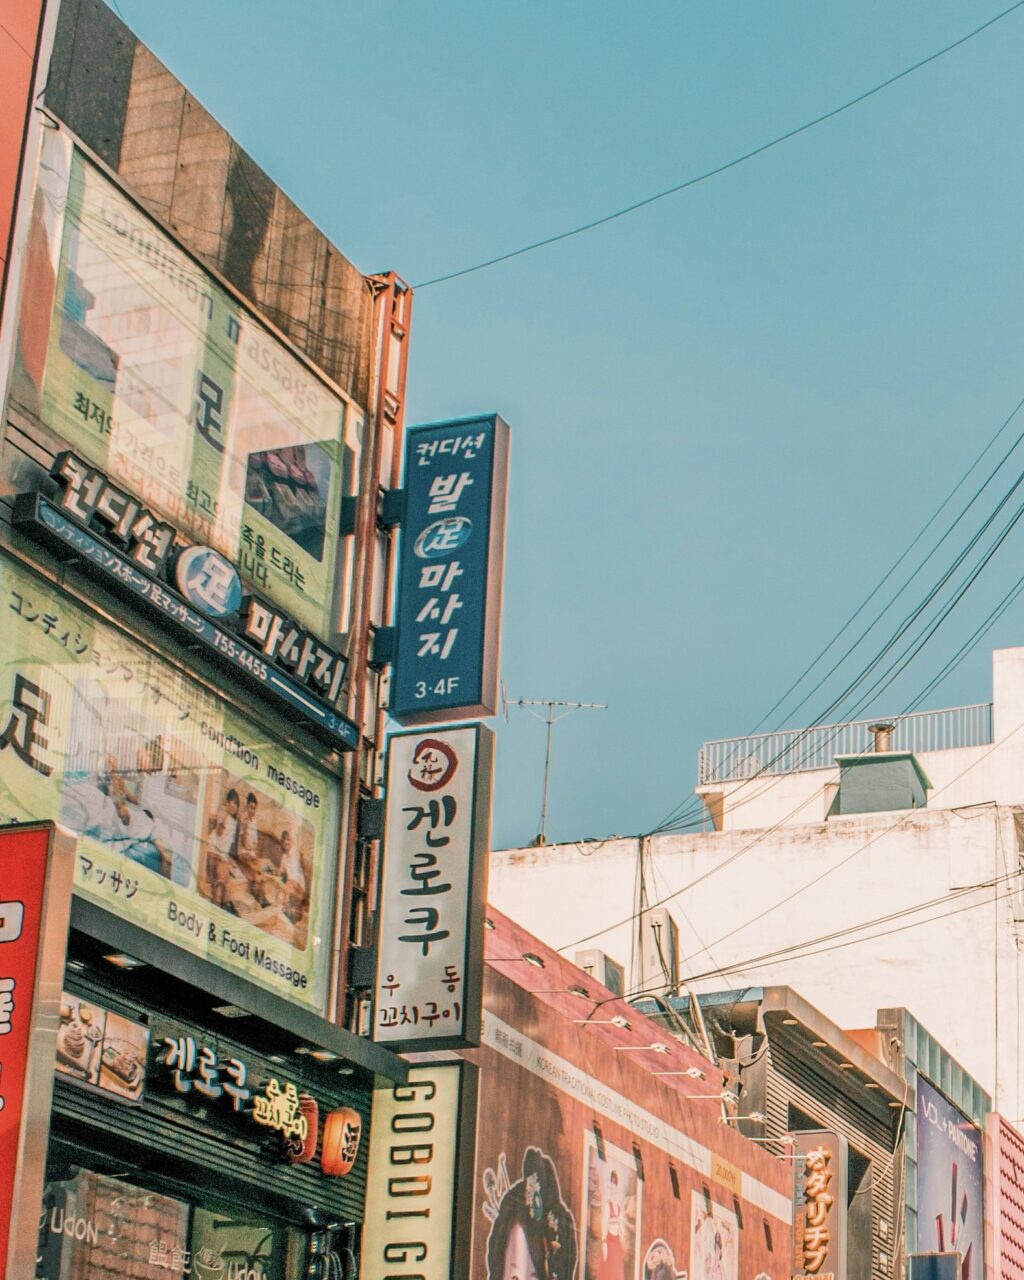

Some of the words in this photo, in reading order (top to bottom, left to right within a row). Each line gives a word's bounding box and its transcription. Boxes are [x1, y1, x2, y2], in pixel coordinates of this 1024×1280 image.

[416, 433, 485, 466] 컨디션
[427, 473, 471, 515] 발
[425, 519, 464, 553] 足
[60, 454, 175, 571] 컨디션
[187, 554, 237, 614] 足
[246, 601, 347, 702] 마사지
[416, 563, 465, 660] 마사지
[213, 630, 268, 681] 755-4455
[0, 672, 54, 778] 足
[267, 765, 321, 809] massage
[398, 795, 457, 957] 겐로쿠
[168, 901, 204, 939] Body
[208, 922, 217, 942] &
[222, 930, 251, 960] Foot
[254, 949, 308, 990] Massage
[379, 1003, 461, 1028] 꼬치구이
[164, 1035, 250, 1113] 겐로쿠
[387, 1079, 437, 1221] GOBDI
